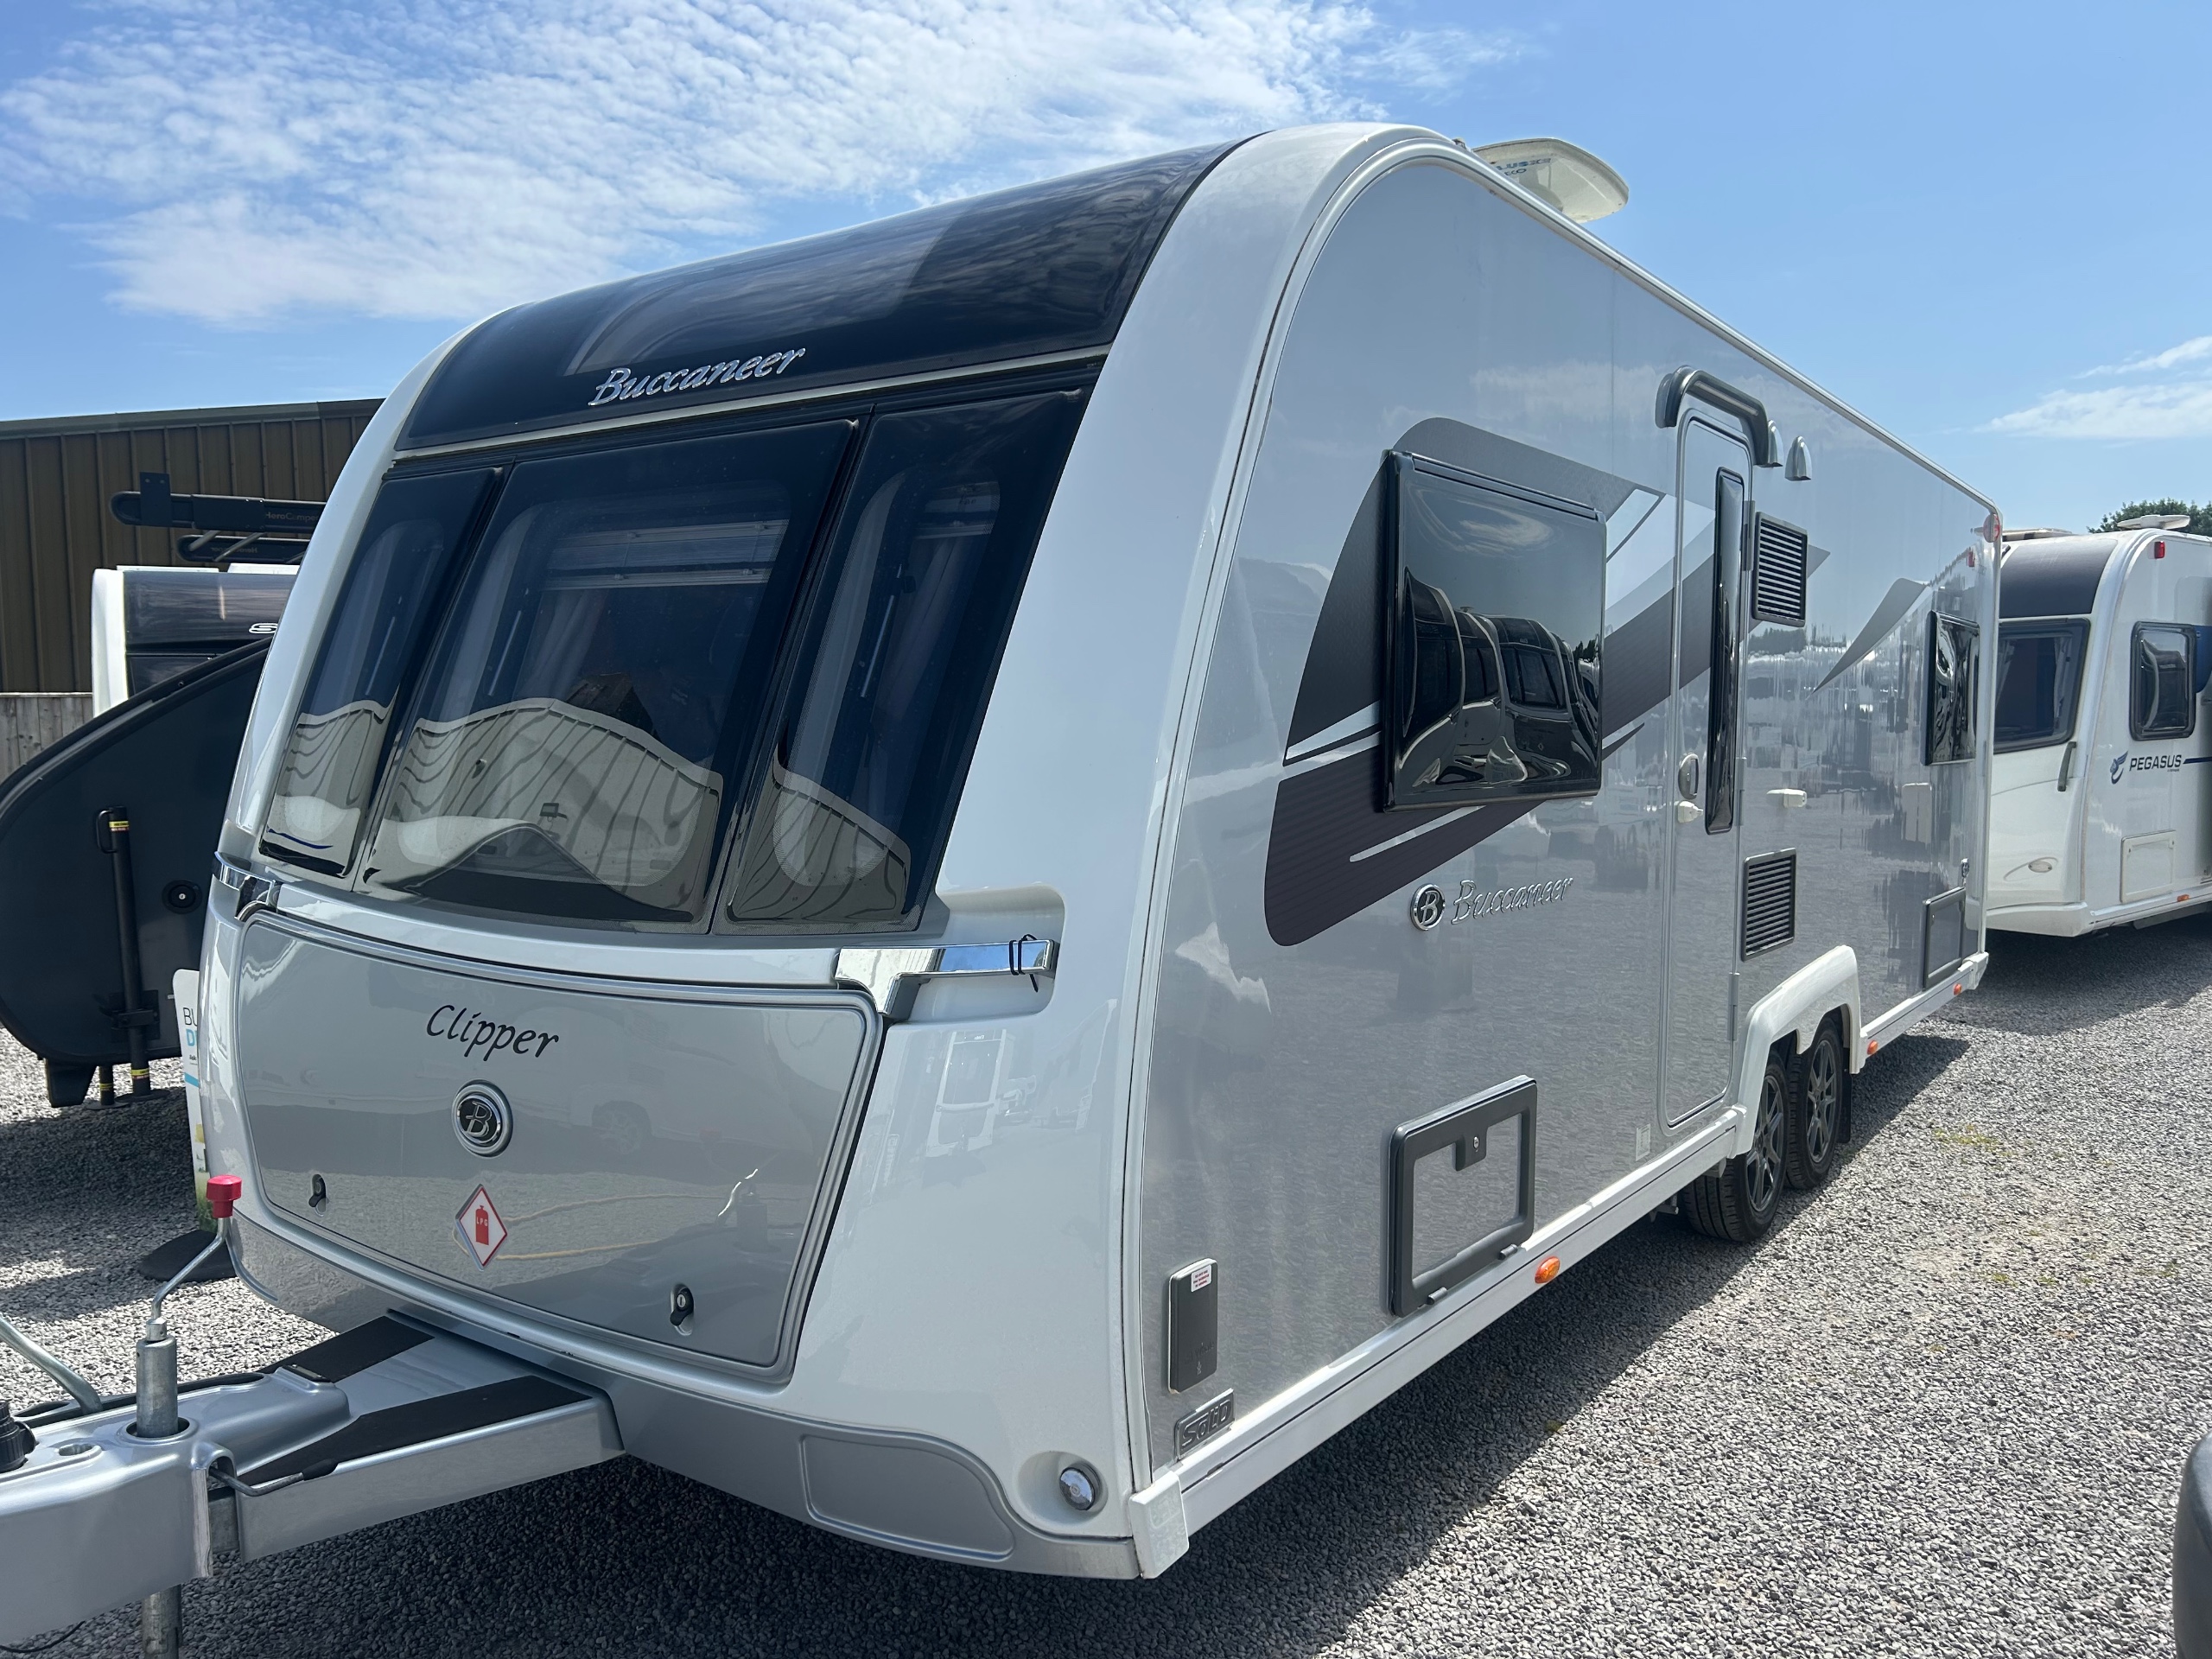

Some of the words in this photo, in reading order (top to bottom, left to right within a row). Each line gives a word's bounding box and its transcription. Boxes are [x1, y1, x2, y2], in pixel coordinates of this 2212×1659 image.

[588, 347, 806, 406] Buccaneer
[265, 512, 319, 523] HeroCmper
[2129, 754, 2183, 772] PEGASUS
[1451, 877, 1574, 925] Buccaneer
[426, 1005, 560, 1062] Clipper
[476, 1217, 488, 1227] LPG
